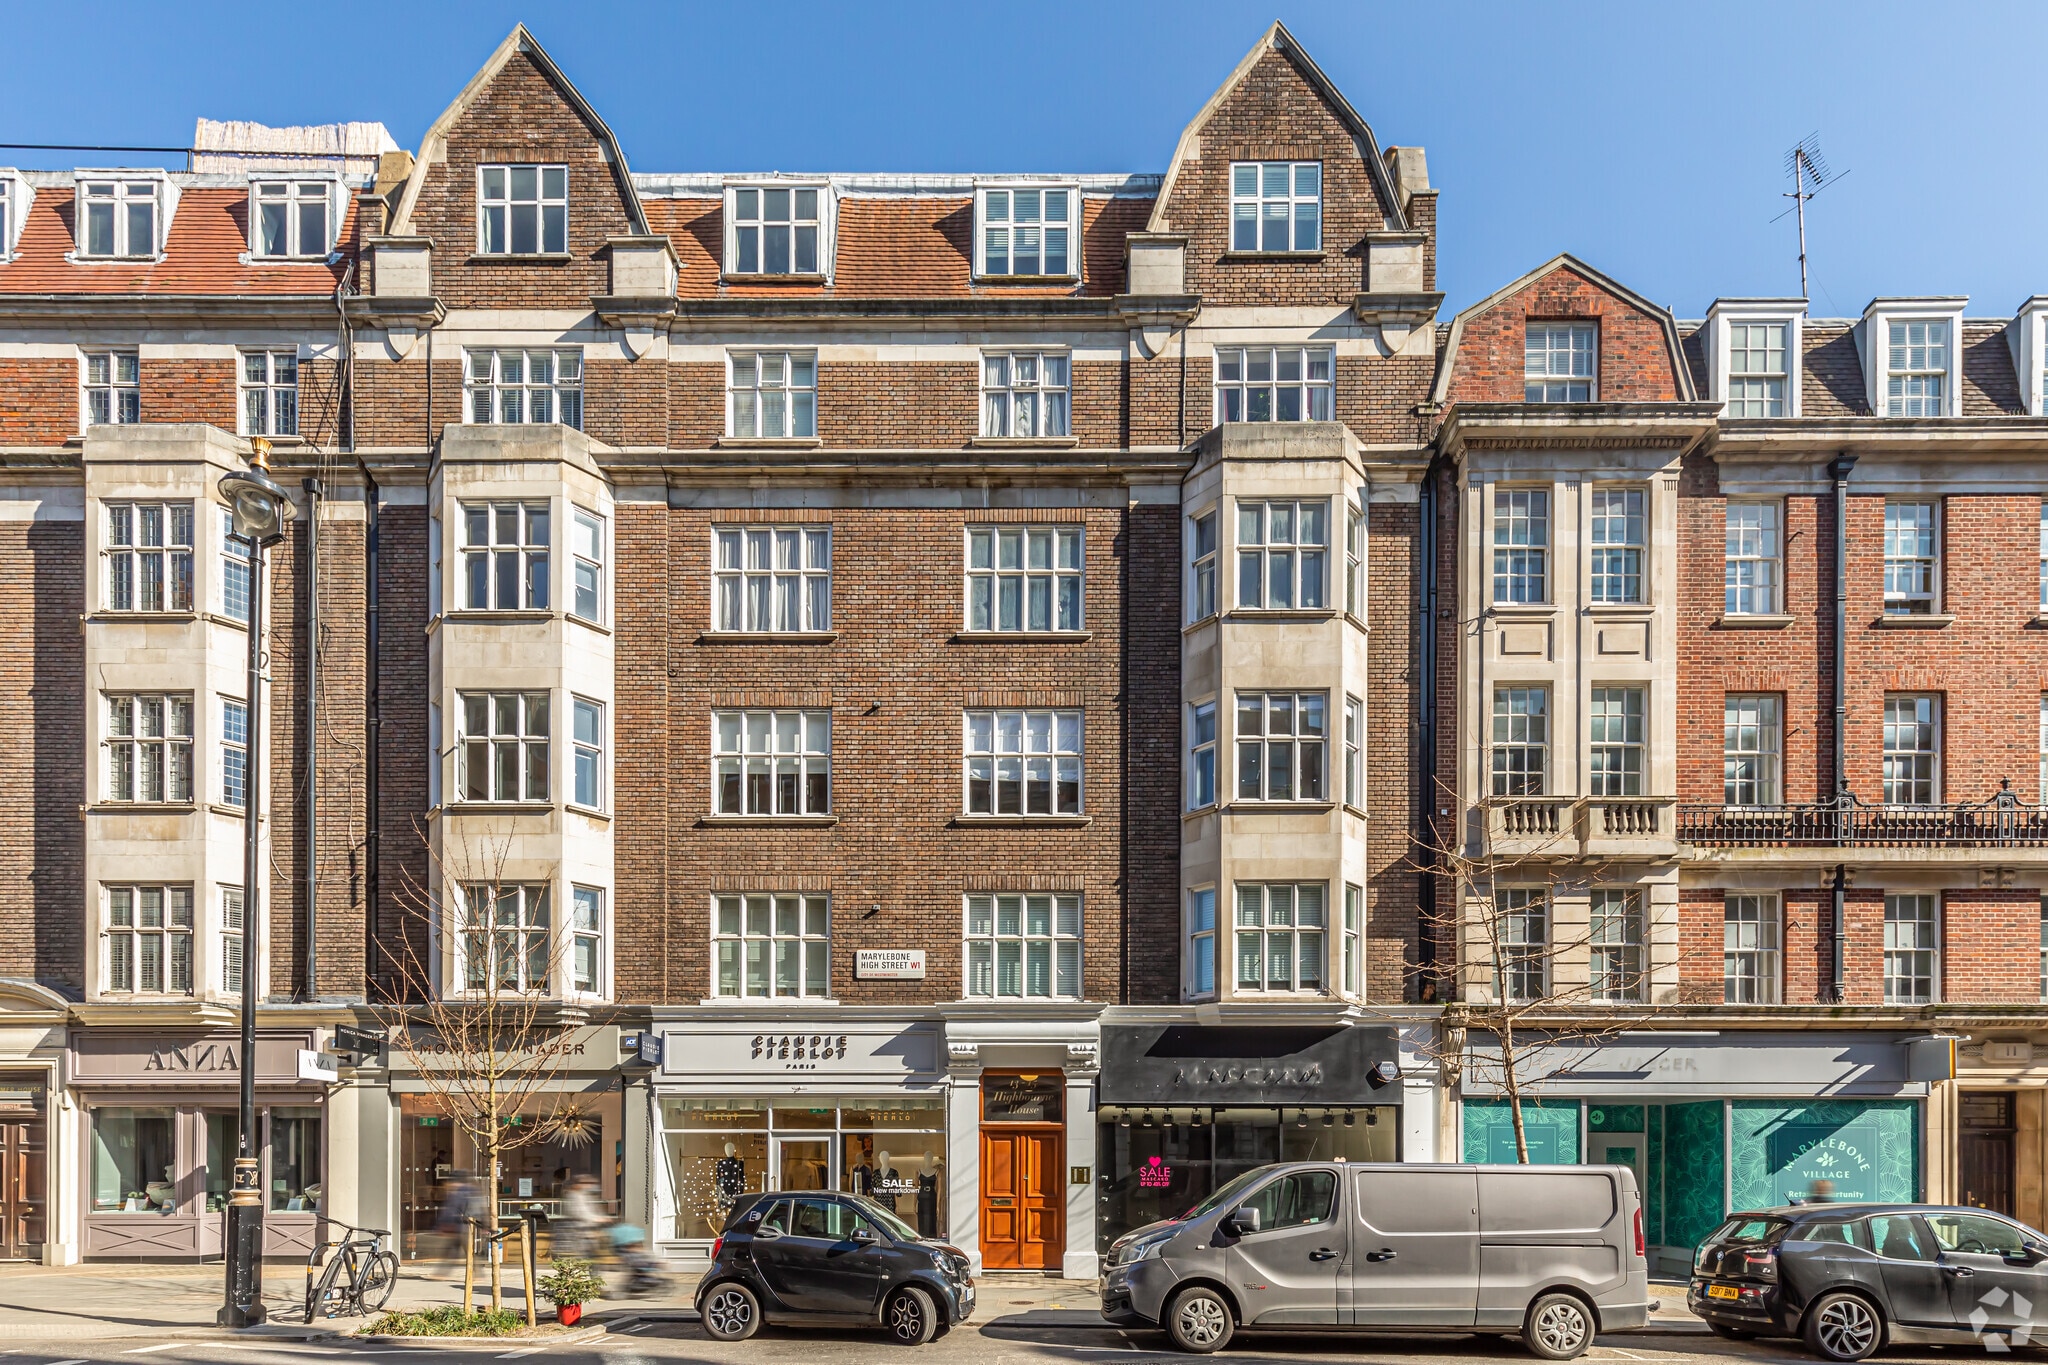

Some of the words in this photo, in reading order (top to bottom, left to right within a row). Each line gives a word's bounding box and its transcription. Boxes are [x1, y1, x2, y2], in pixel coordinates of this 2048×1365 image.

[754, 1035, 848, 1046] CLAUDIE
[753, 1047, 848, 1058] PIERLOT
[994, 1091, 1054, 1105] Highbourne
[1008, 1105, 1040, 1114] House
[1783, 1138, 1871, 1172] MARYLEBONE
[1140, 1166, 1171, 1177] SALE
[882, 1179, 913, 1187] SALE
[1724, 1289, 1736, 1297] BNA
